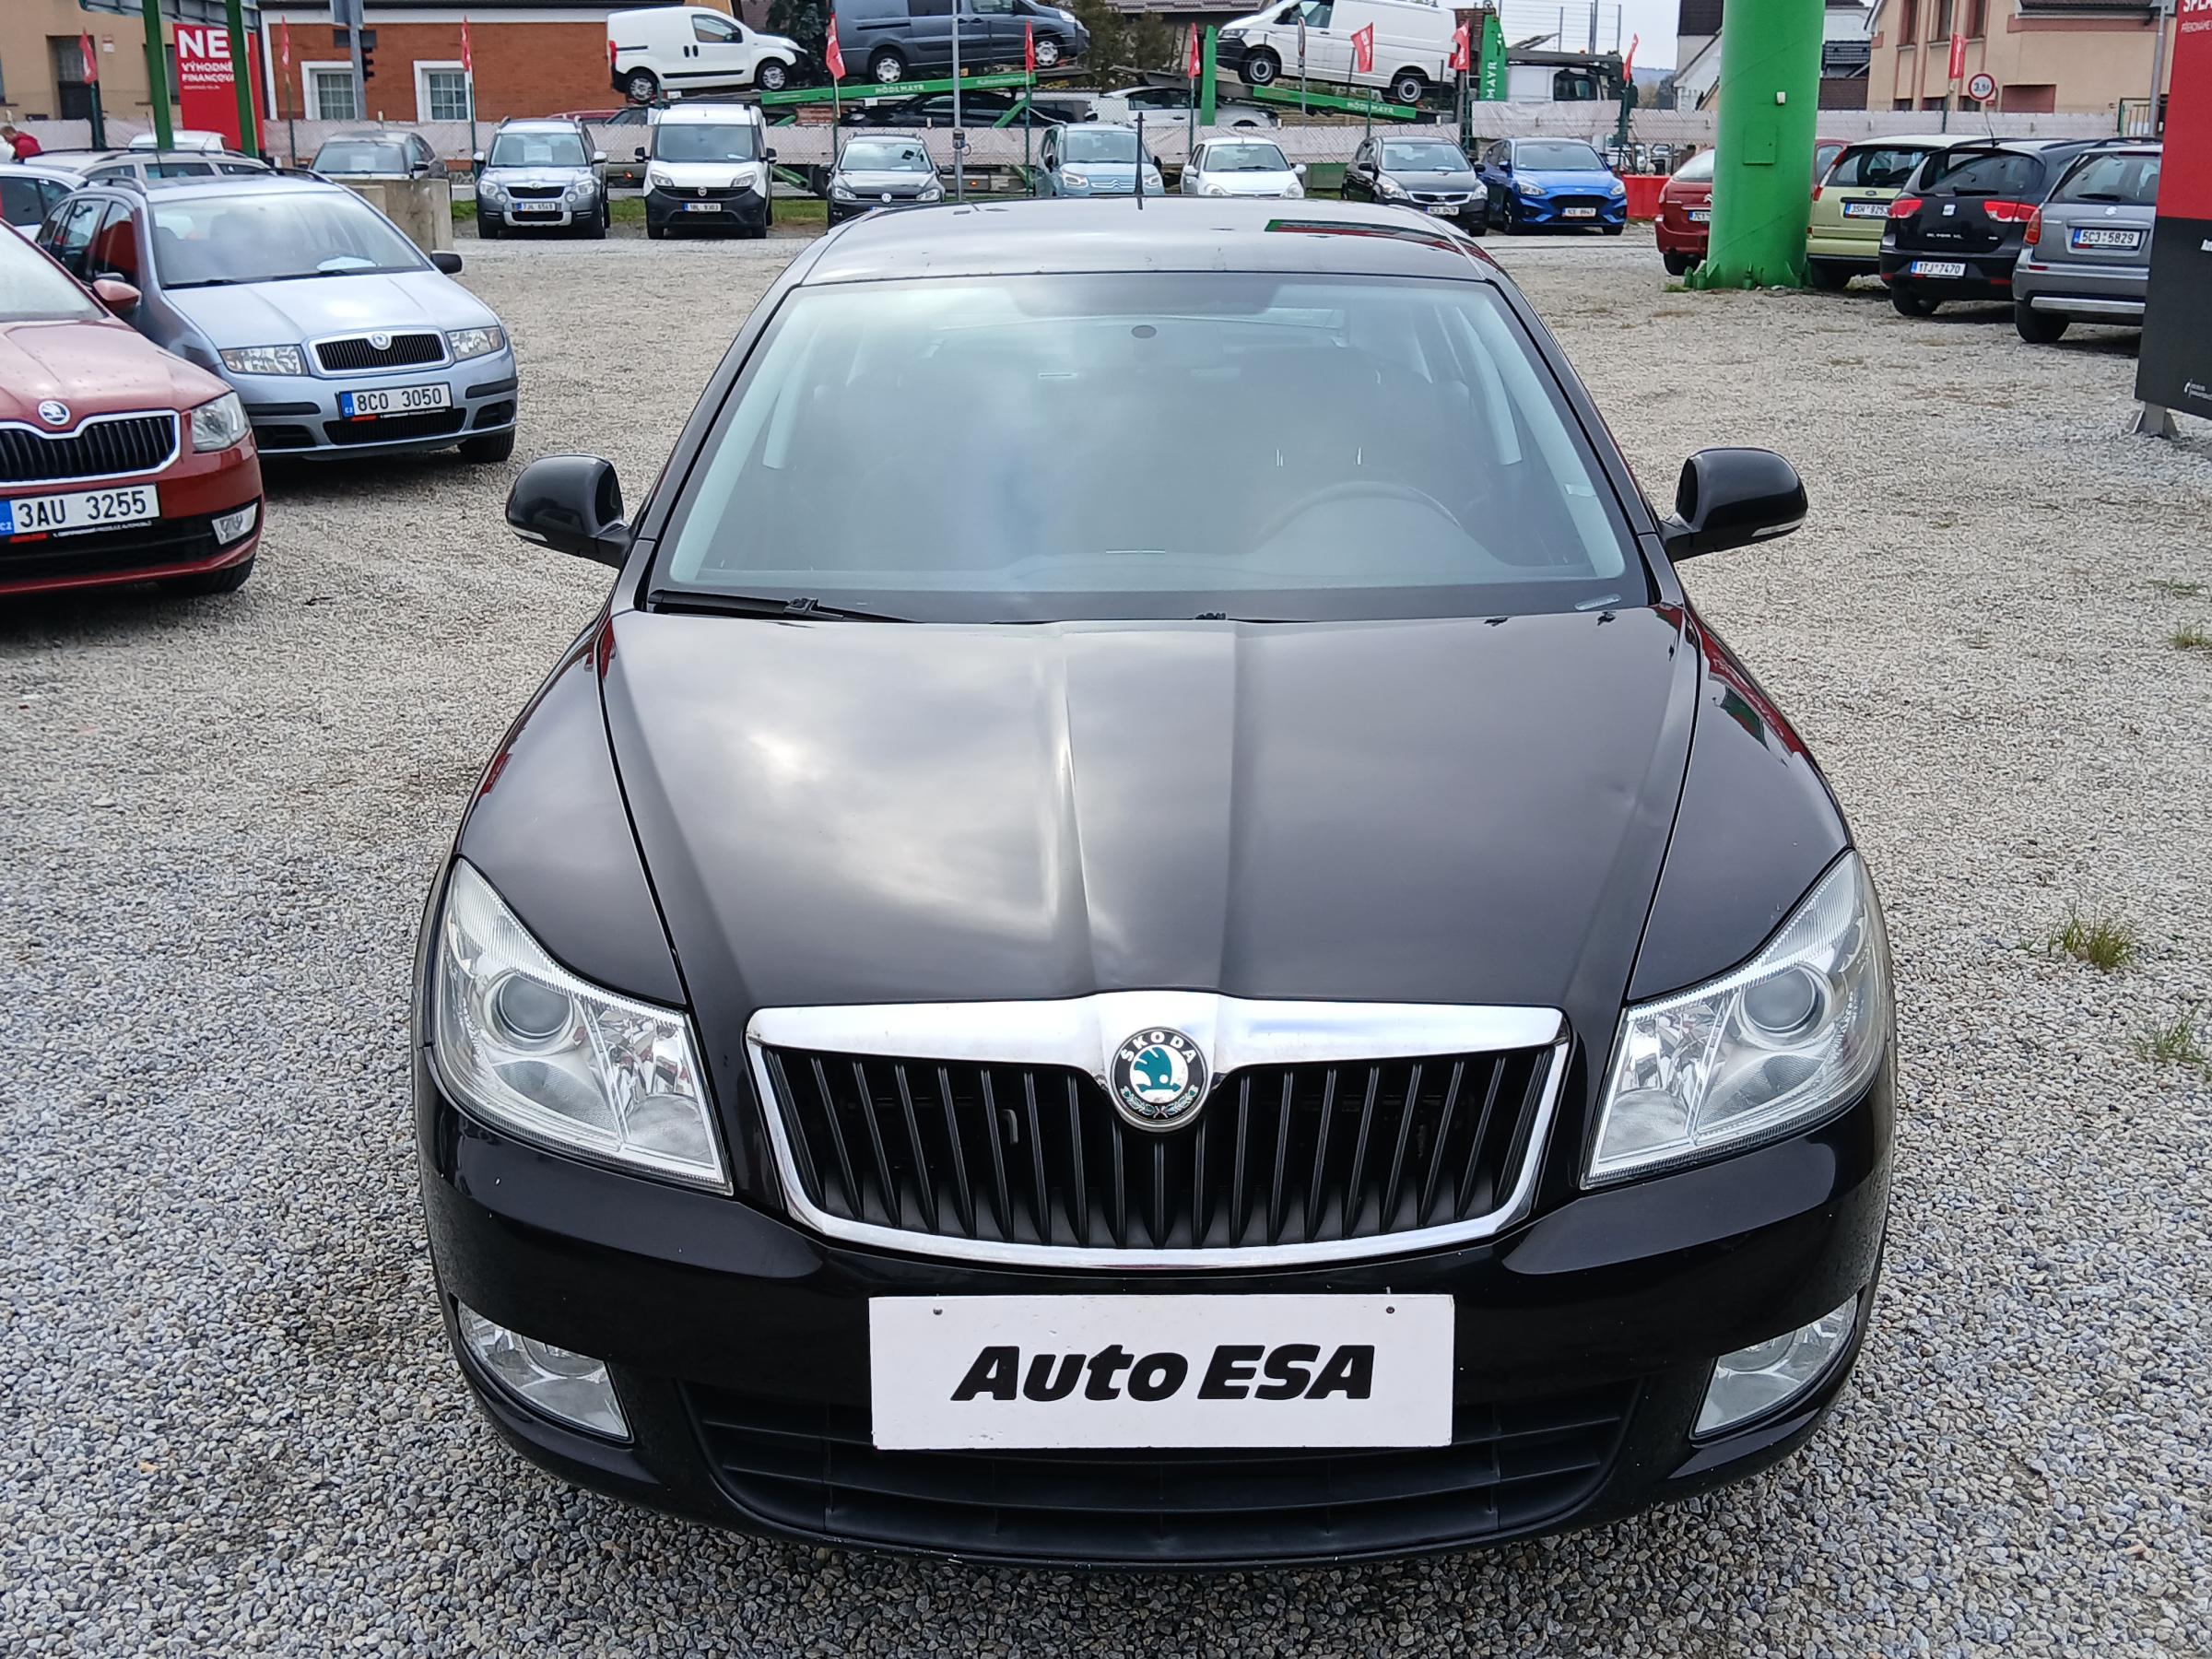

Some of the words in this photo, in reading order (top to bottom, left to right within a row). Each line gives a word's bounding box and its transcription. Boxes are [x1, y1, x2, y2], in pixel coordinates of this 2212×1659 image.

[178, 29, 249, 59] NE
[2082, 230, 2101, 242] 5C3
[2108, 232, 2135, 244] 5829
[402, 387, 442, 407] 3050
[18, 499, 66, 528] 3AU
[85, 490, 147, 521] 3255
[949, 1345, 1189, 1403] Auto
[1197, 1345, 1375, 1400] ESA
